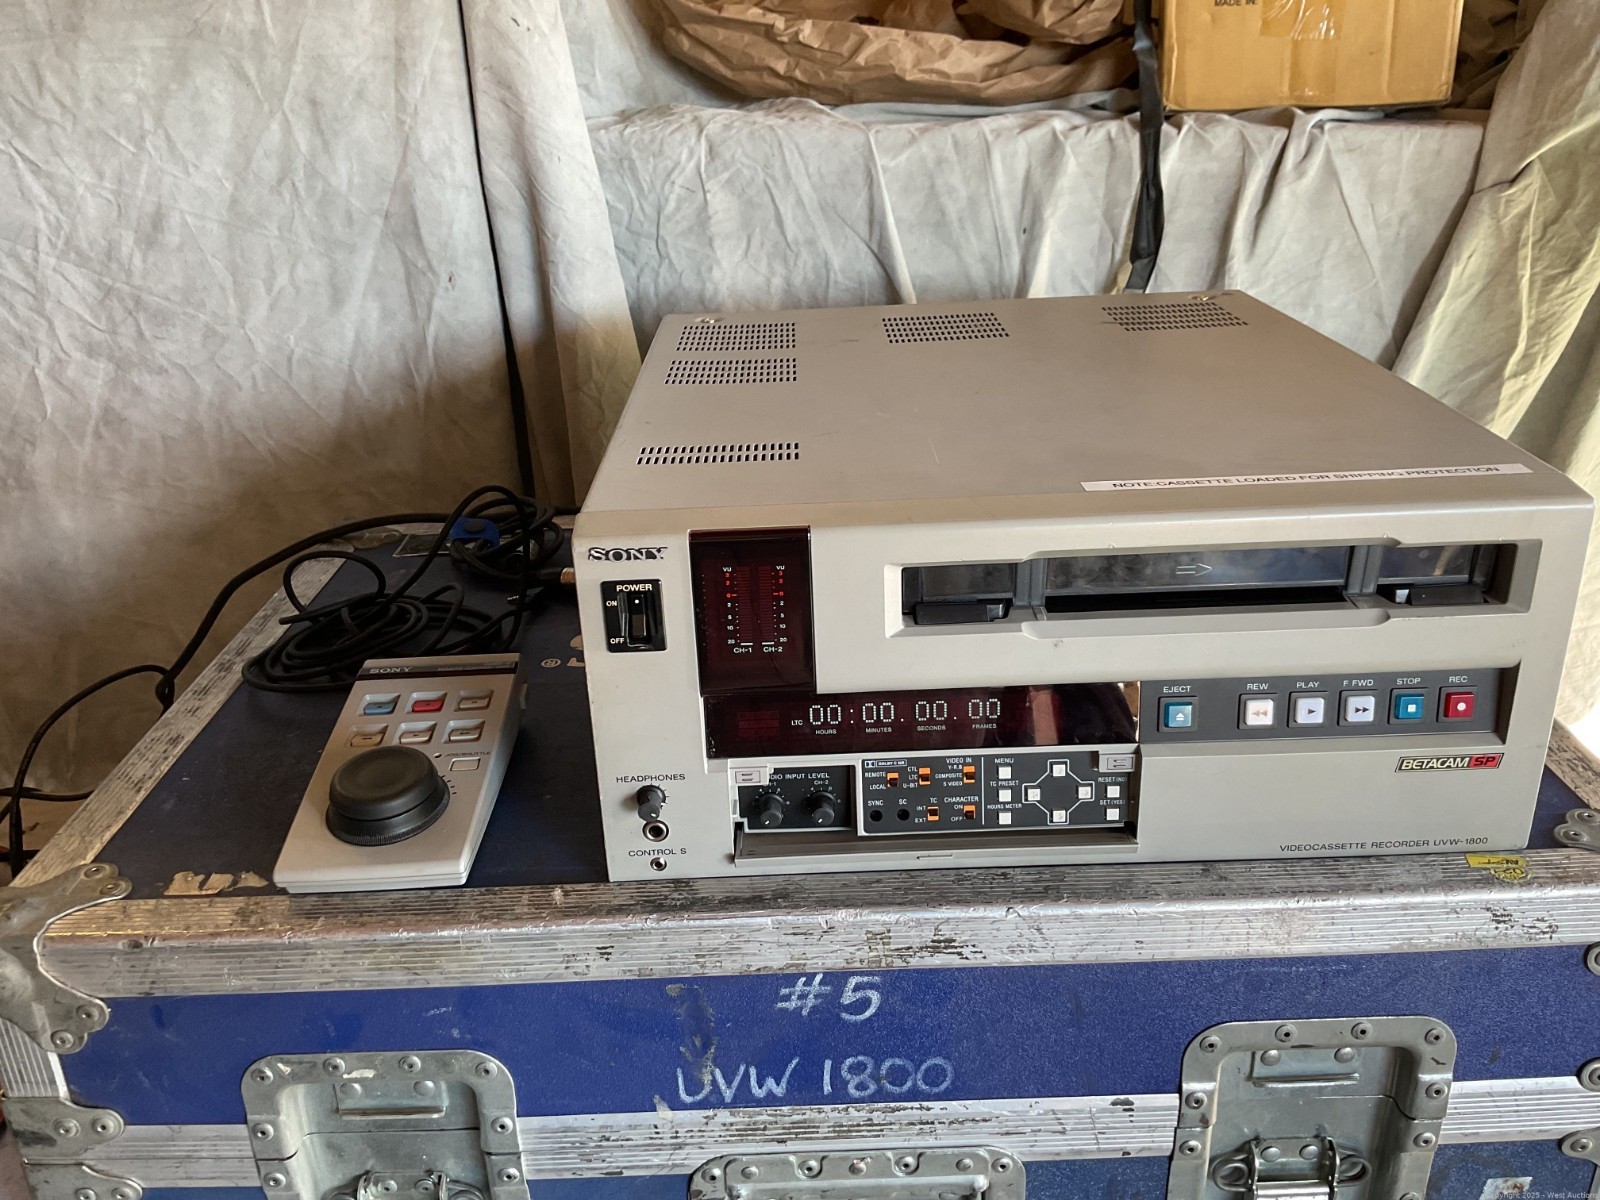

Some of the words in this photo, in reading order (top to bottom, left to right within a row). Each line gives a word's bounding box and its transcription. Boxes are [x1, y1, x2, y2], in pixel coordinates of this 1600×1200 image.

[1236, 475, 1296, 484] LOADED
[1334, 471, 1403, 479] SHIPPING
[1405, 466, 1500, 476] PROTECTION
[588, 547, 668, 562] SONY
[616, 584, 652, 592] POWER
[370, 666, 412, 674] SONY
[1401, 758, 1469, 770] BETACAM
[1473, 756, 1496, 767] SP
[616, 774, 686, 783] HEADPHONES
[1280, 842, 1367, 852] VIDEOCASSETTE
[1371, 840, 1430, 849] RECORDER
[1434, 837, 1488, 846] UVW-1800
[628, 848, 676, 857] CONTROL
[677, 1056, 799, 1103] UVW
[823, 1055, 955, 1098] 1800
